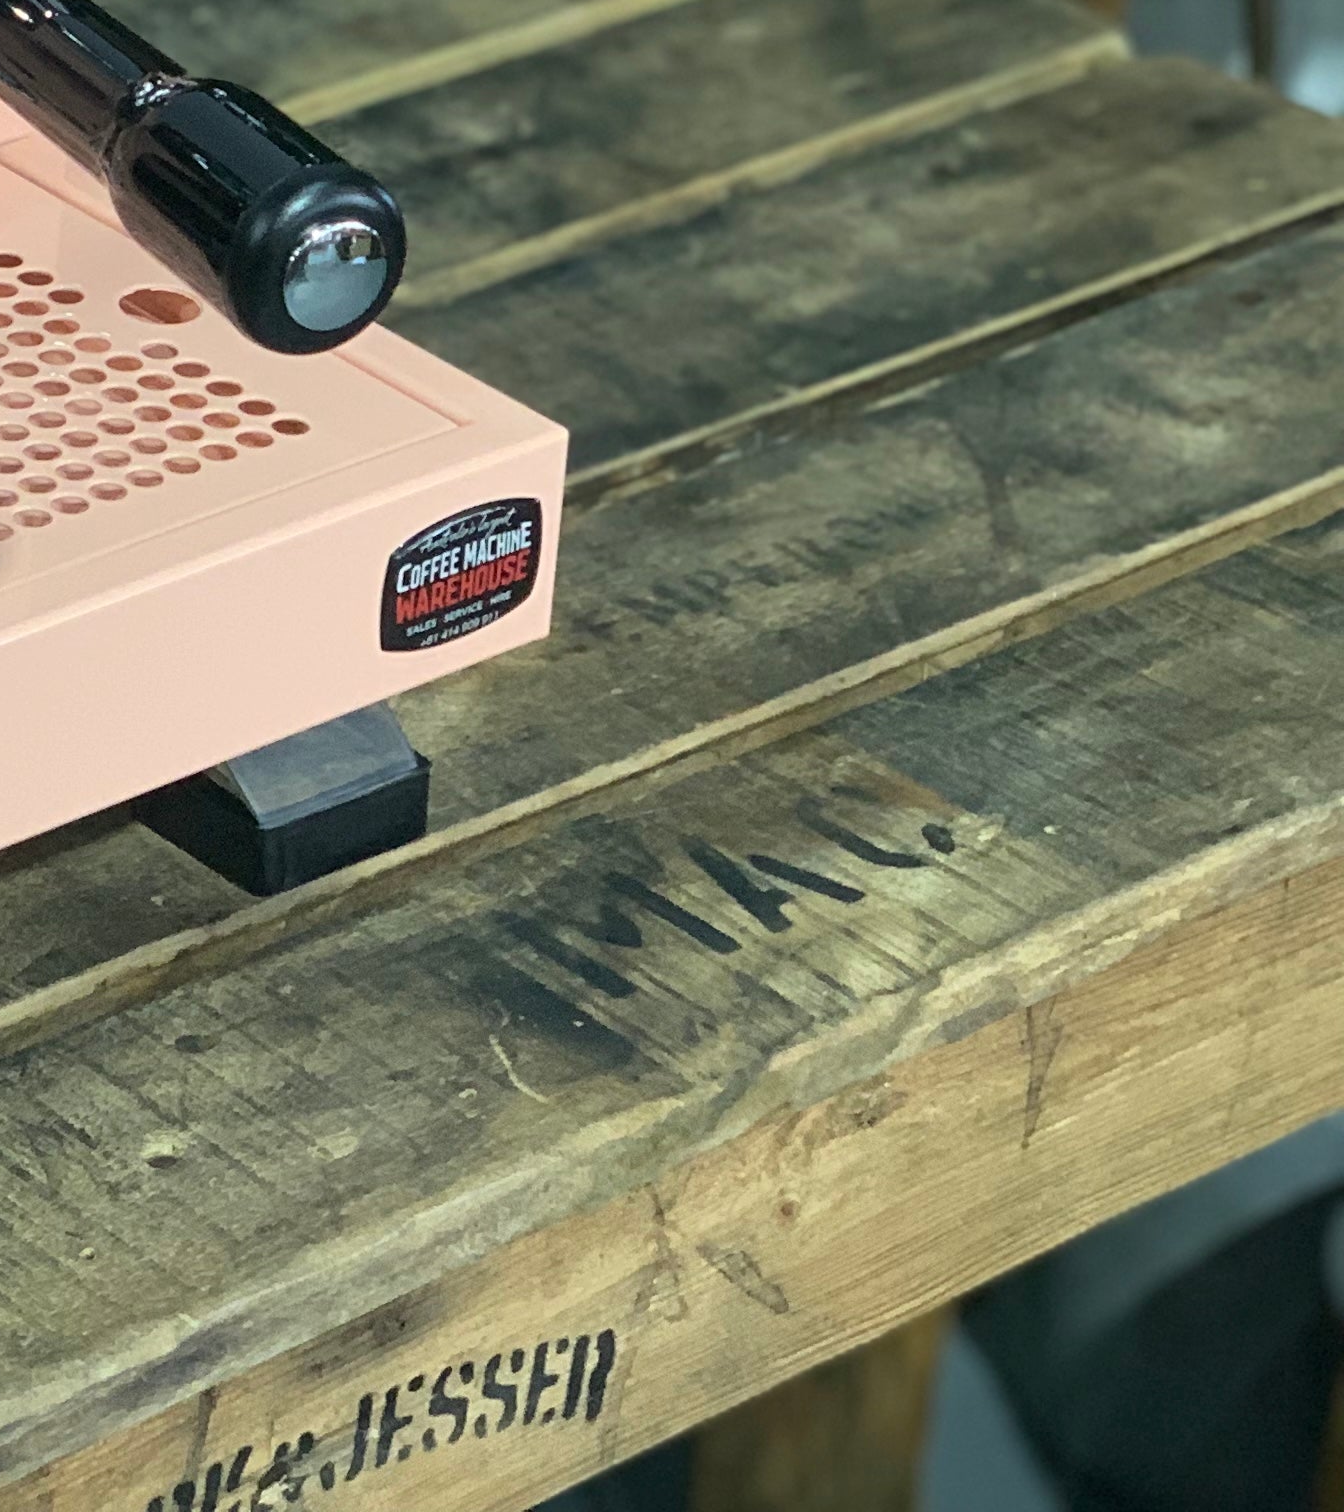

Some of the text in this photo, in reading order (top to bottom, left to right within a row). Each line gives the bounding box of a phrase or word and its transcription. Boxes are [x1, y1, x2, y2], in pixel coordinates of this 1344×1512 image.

[395, 548, 532, 625] WAREHOUSE
[396, 521, 533, 594] COFFEE MACHINE
[443, 600, 484, 623] SERVICE
